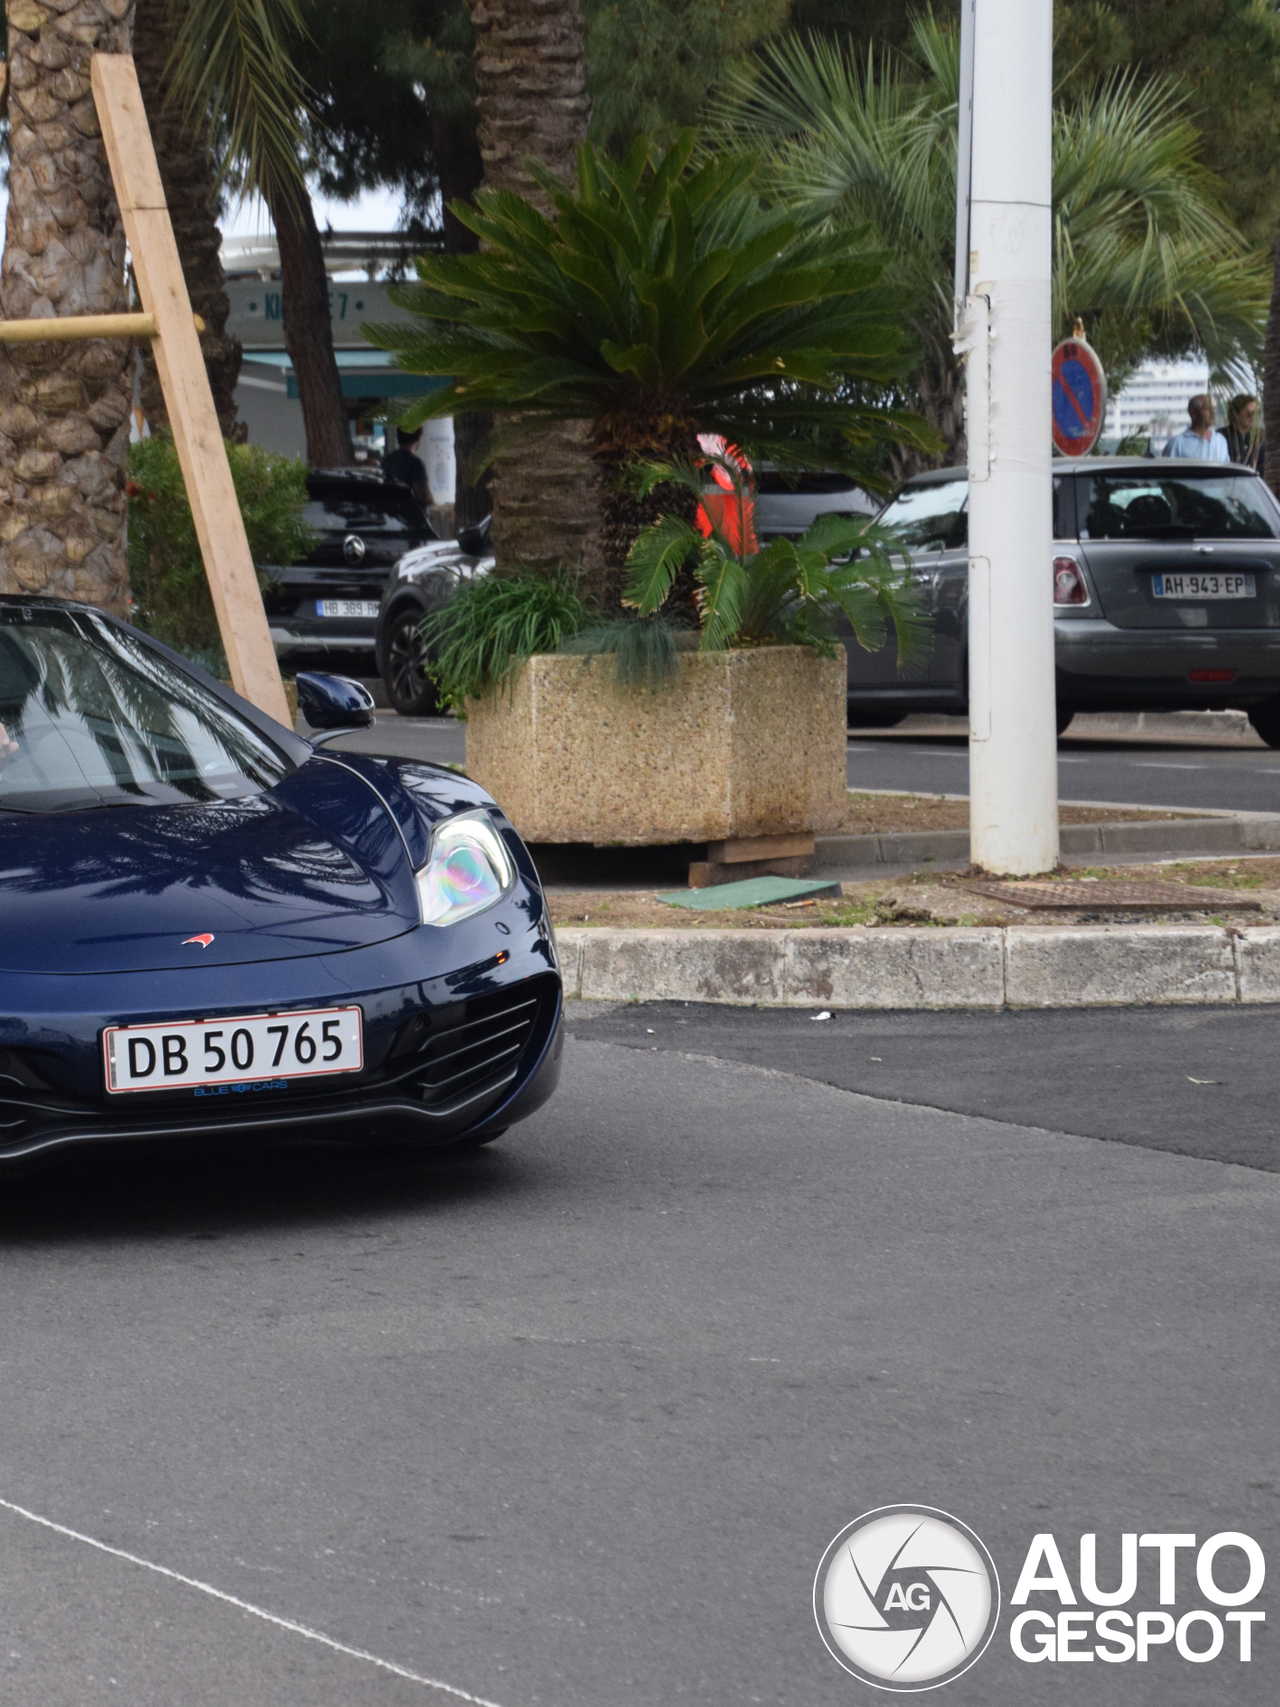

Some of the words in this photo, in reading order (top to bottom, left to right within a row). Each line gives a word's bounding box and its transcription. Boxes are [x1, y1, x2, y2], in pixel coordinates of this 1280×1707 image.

[338, 293, 349, 320] 7
[127, 1034, 189, 1078] DB
[203, 1028, 254, 1073] 50
[267, 1019, 343, 1067] 765
[194, 1086, 229, 1097] BLUE
[252, 1080, 288, 1092] CARS
